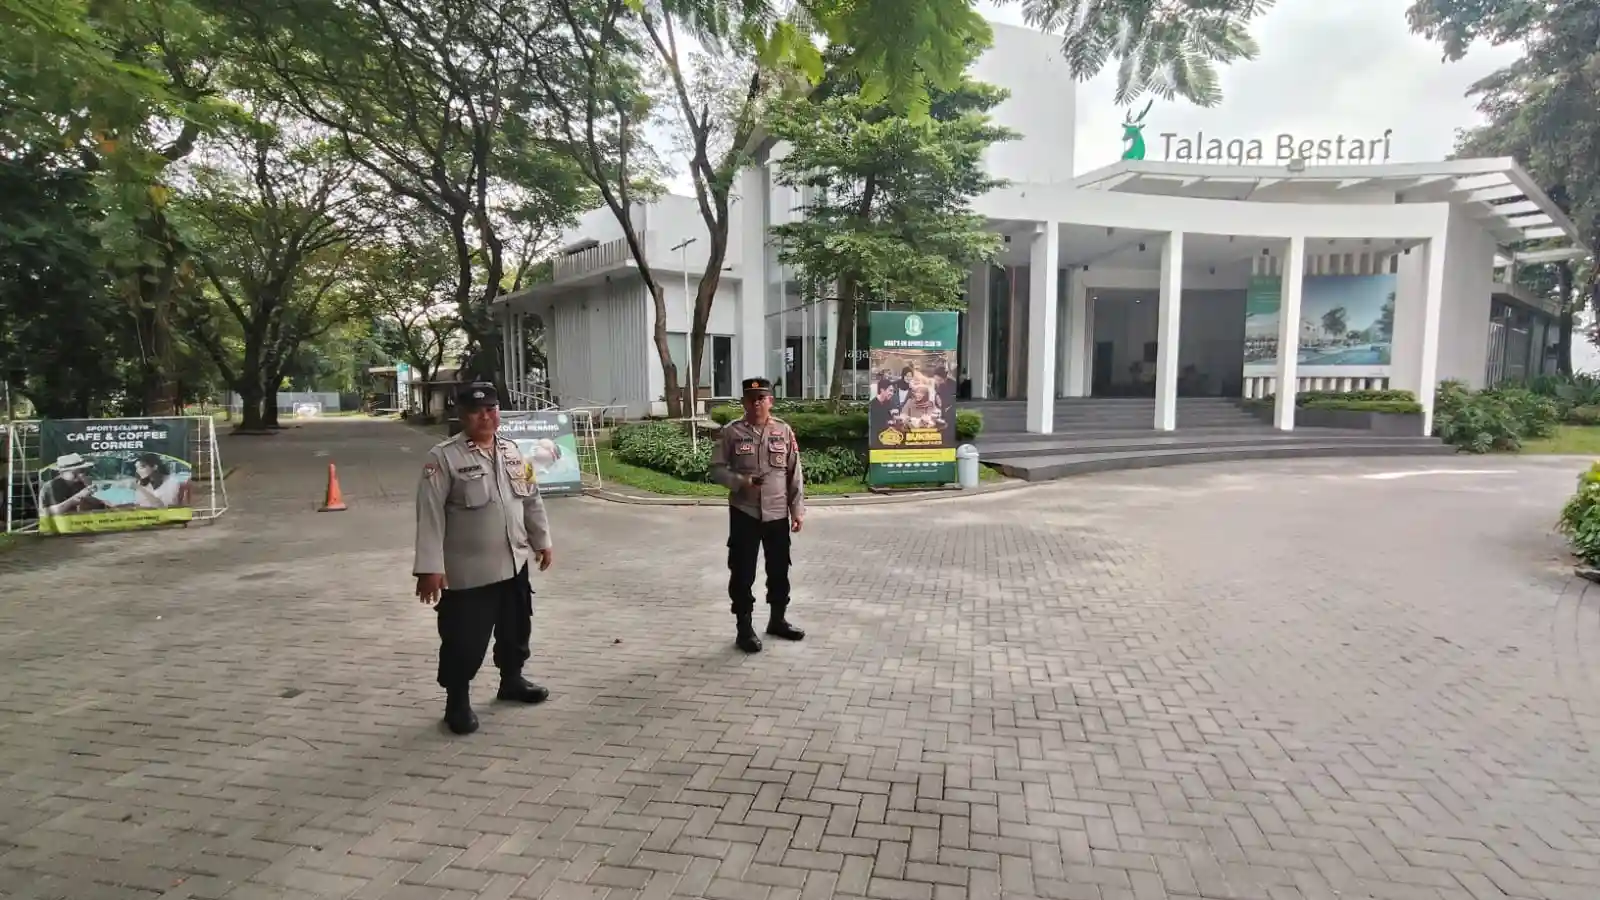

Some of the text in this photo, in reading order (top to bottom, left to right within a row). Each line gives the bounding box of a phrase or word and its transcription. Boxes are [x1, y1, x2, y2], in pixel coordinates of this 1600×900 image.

[1160, 128, 1392, 165] Talaga Bestari
[66, 431, 167, 441] CAFE & COFFEE
[91, 440, 143, 450] CORNER
